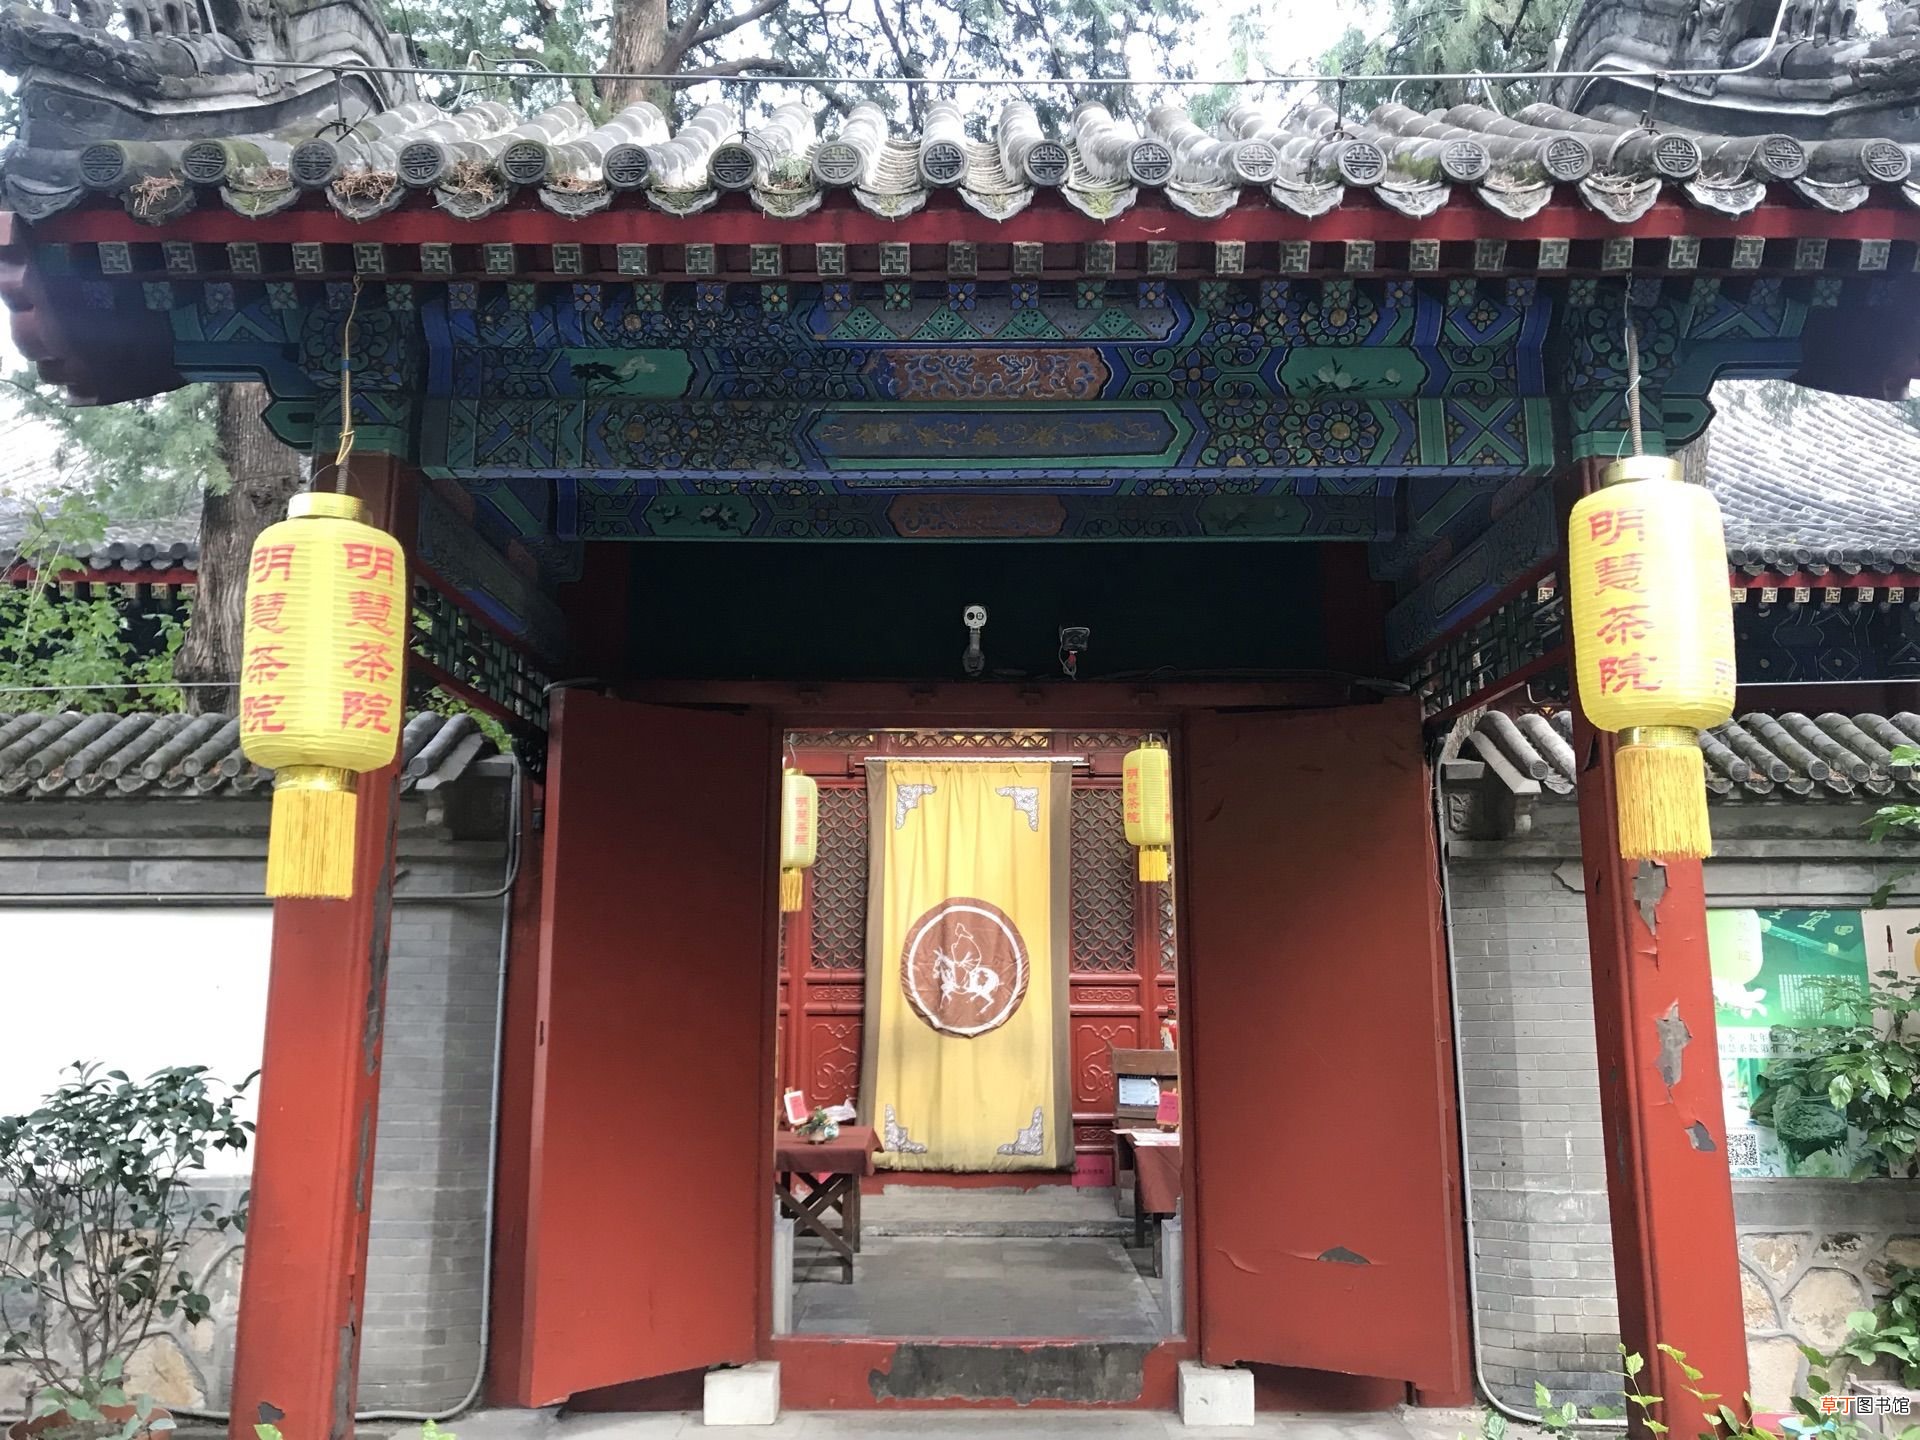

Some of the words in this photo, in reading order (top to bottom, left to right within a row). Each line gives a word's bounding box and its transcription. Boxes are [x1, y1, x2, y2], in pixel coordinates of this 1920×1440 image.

[242, 543, 296, 733] 明慧茶院
[341, 542, 396, 734] 明慧茶院
[1588, 507, 1663, 697] 明慧茶院
